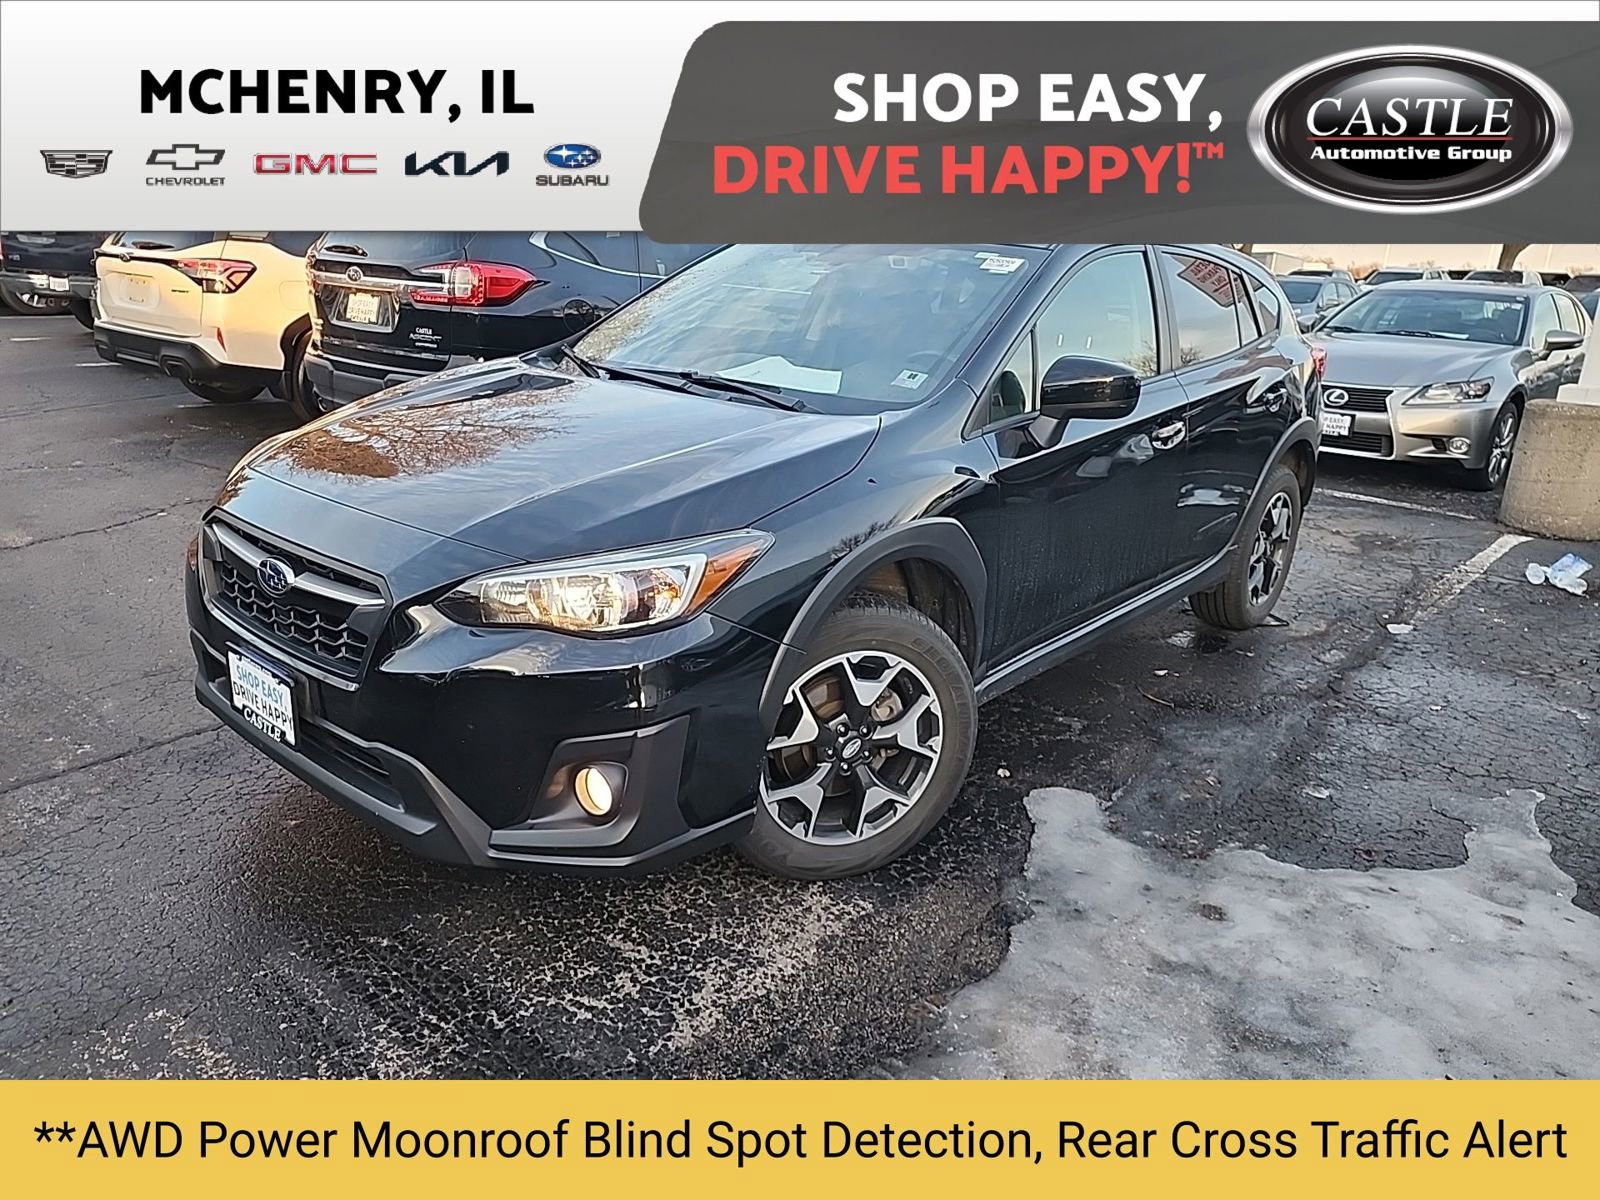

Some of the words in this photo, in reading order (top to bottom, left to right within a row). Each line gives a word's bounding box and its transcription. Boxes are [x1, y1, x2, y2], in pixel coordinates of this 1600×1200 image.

[233, 681, 260, 709] DRIVE
[261, 701, 294, 731] HAPPY
[235, 664, 260, 690] SHOP
[261, 679, 284, 708] EASY
[243, 707, 282, 741] CASTLE
